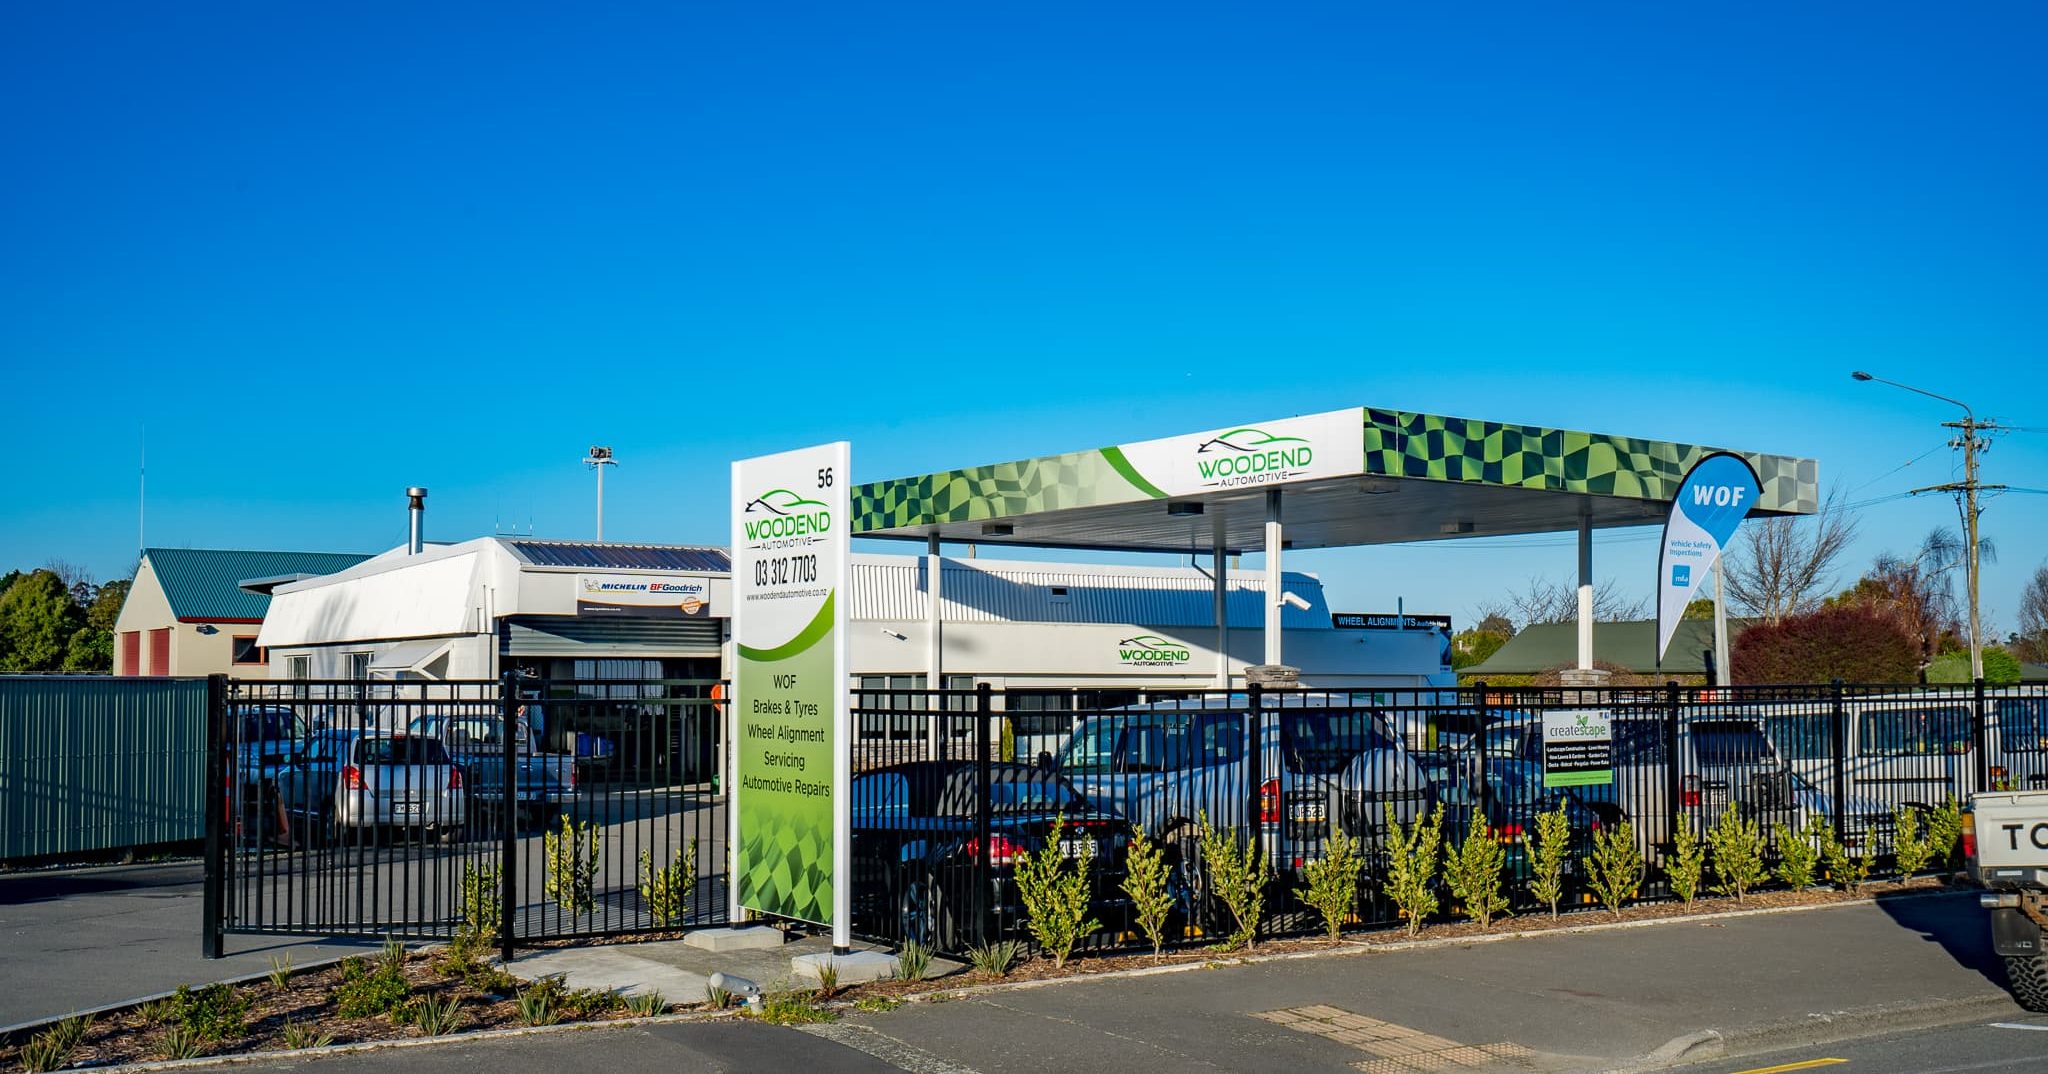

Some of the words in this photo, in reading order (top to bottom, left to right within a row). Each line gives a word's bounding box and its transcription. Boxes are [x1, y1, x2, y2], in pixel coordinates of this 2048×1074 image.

[1198, 447, 1312, 479] WOODEND
[818, 467, 833, 488] 56
[1220, 471, 1288, 487] AUTOMOTIVE
[1693, 485, 1745, 507] WOF
[745, 511, 831, 541] WOODEND
[761, 537, 812, 551] AUTOMOTIVE
[1671, 540, 1692, 548] Vehicle
[1693, 541, 1712, 550] Safety
[1670, 549, 1702, 557] Inspections
[755, 559, 768, 586] 03
[771, 558, 787, 585] 312
[792, 554, 817, 583] 7703
[601, 583, 648, 591] MICHELIN
[650, 583, 703, 592] BFGoodrich
[746, 588, 827, 601] www.woodendautomotive.co.nz
[1337, 616, 1366, 626] WHEEL
[1367, 616, 1416, 627] ALIGNMNTS
[1119, 649, 1190, 661] WOODEND
[773, 674, 797, 689] WOF
[753, 699, 782, 715] Brakes
[785, 699, 791, 715] &
[794, 700, 818, 718] Tyres
[747, 723, 775, 740] Wheel
[777, 725, 825, 744] Alignment
[1550, 725, 1606, 738] createscape
[764, 750, 805, 771] Servicing
[742, 774, 792, 793] Automotive
[795, 779, 830, 797] Repairs
[2002, 822, 2048, 850] TO
